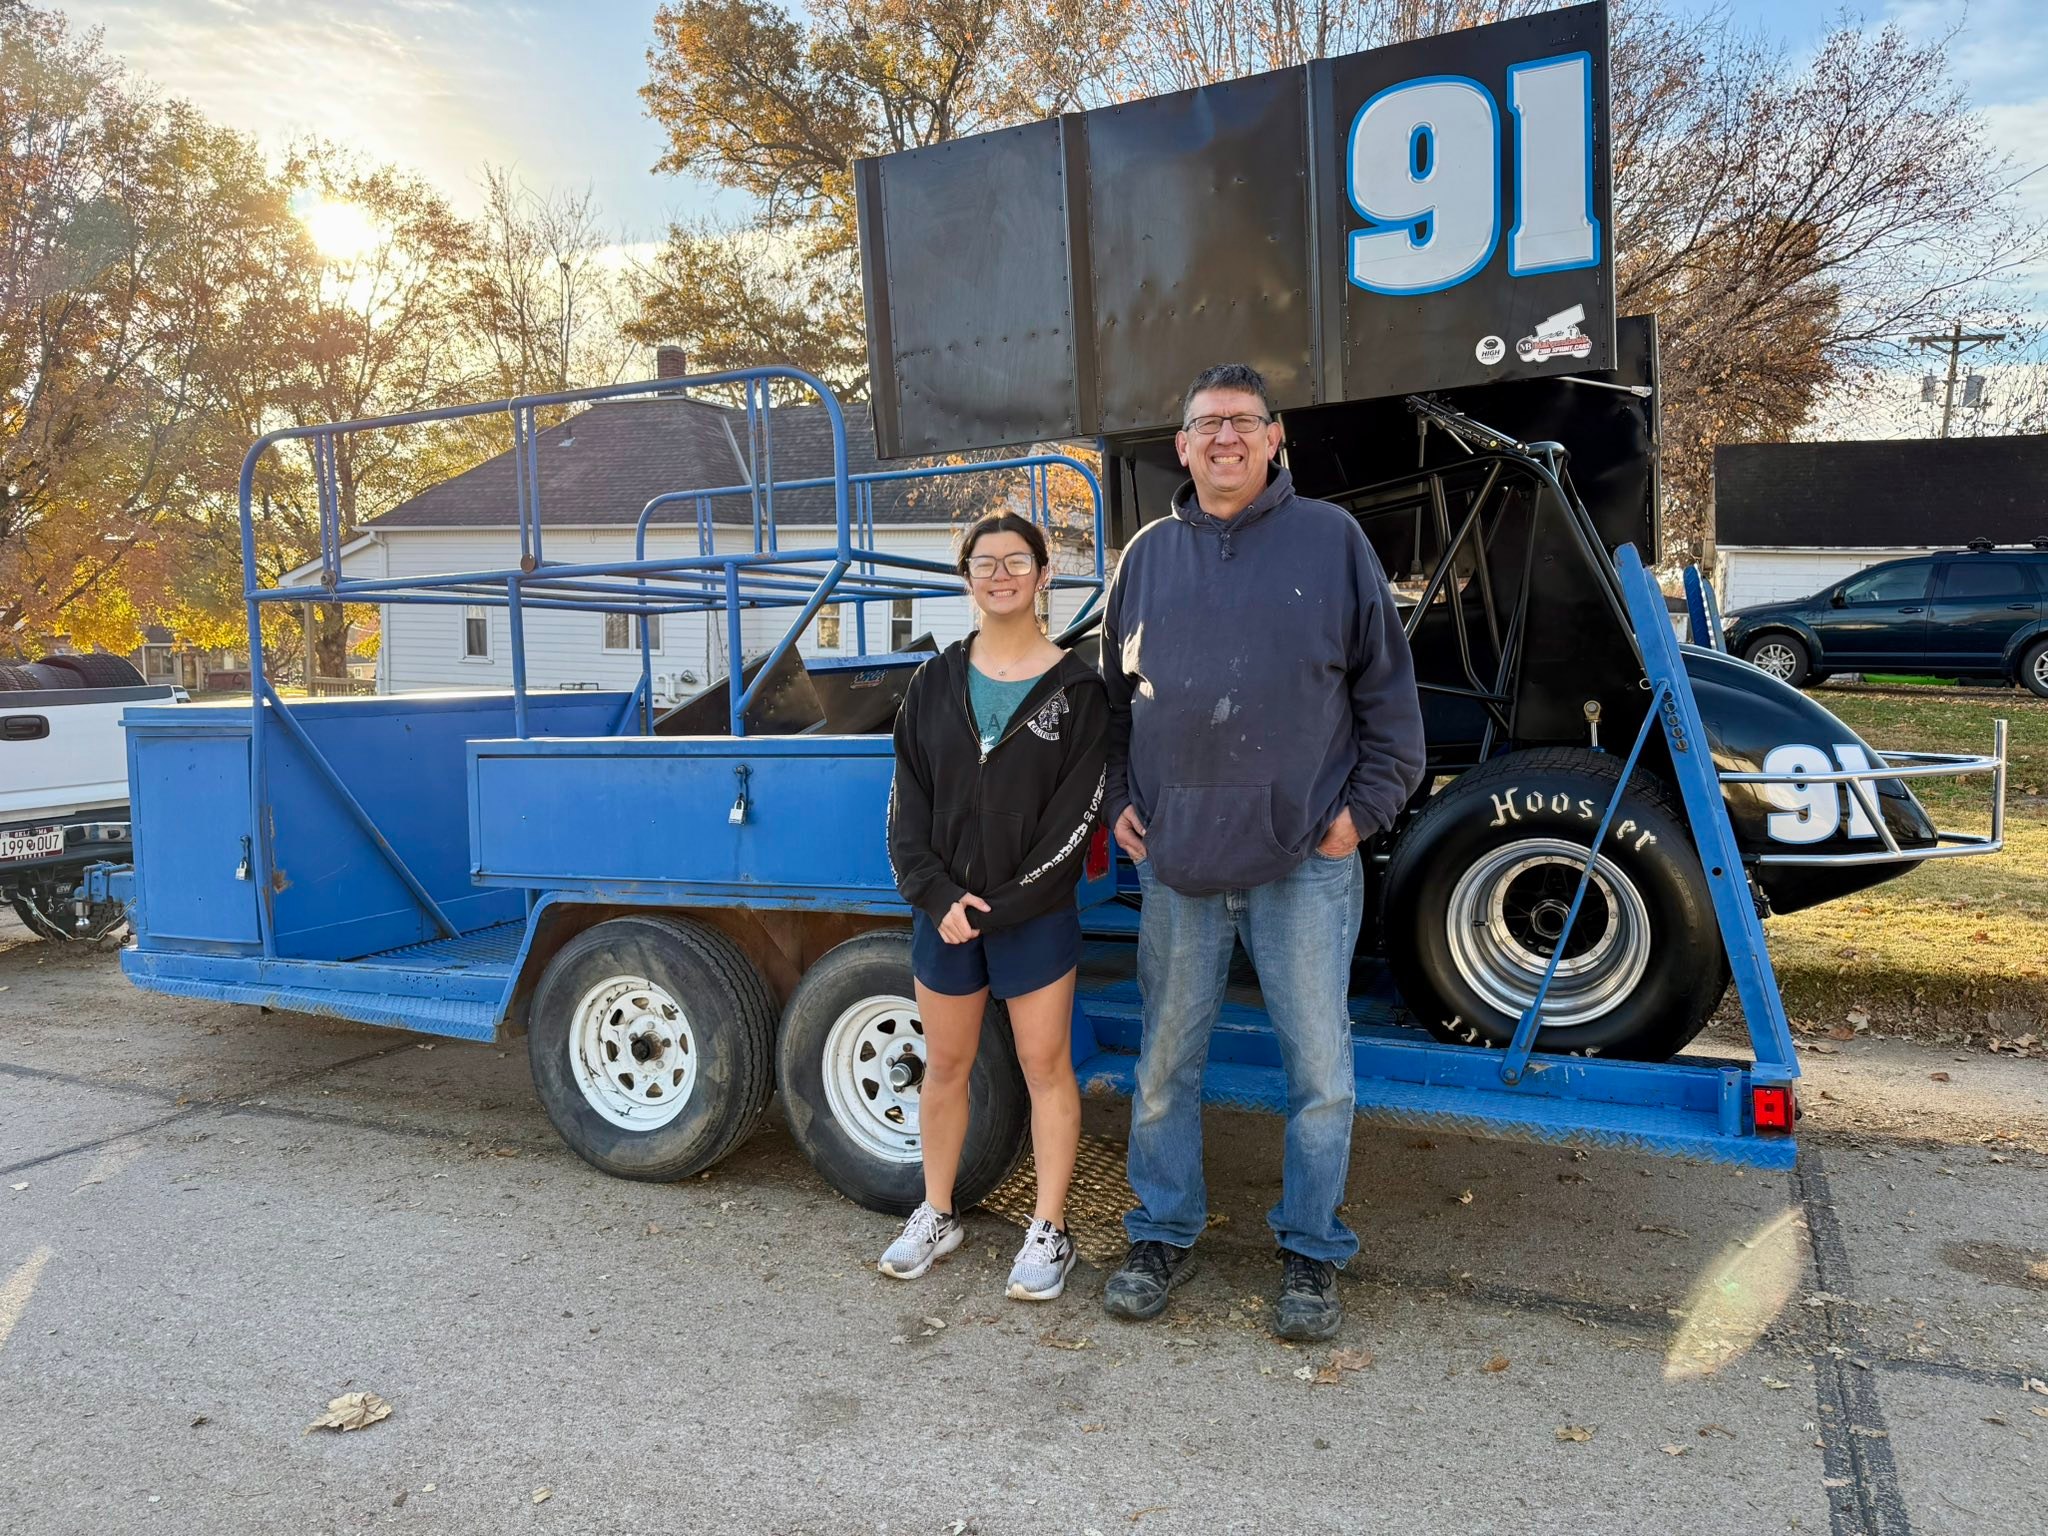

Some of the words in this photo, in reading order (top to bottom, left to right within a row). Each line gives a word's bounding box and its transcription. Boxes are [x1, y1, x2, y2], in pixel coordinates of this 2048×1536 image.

[1347, 51, 1600, 295] 91
[1481, 349, 1500, 357] HIGH
[1030, 723, 1060, 740] CALIFORNI
[1763, 743, 1886, 844] 91
[1083, 810, 1095, 822] OF
[1489, 786, 1657, 851] Hooser
[1, 840, 23, 856] 199
[1019, 822, 1089, 887] ANARCHY
